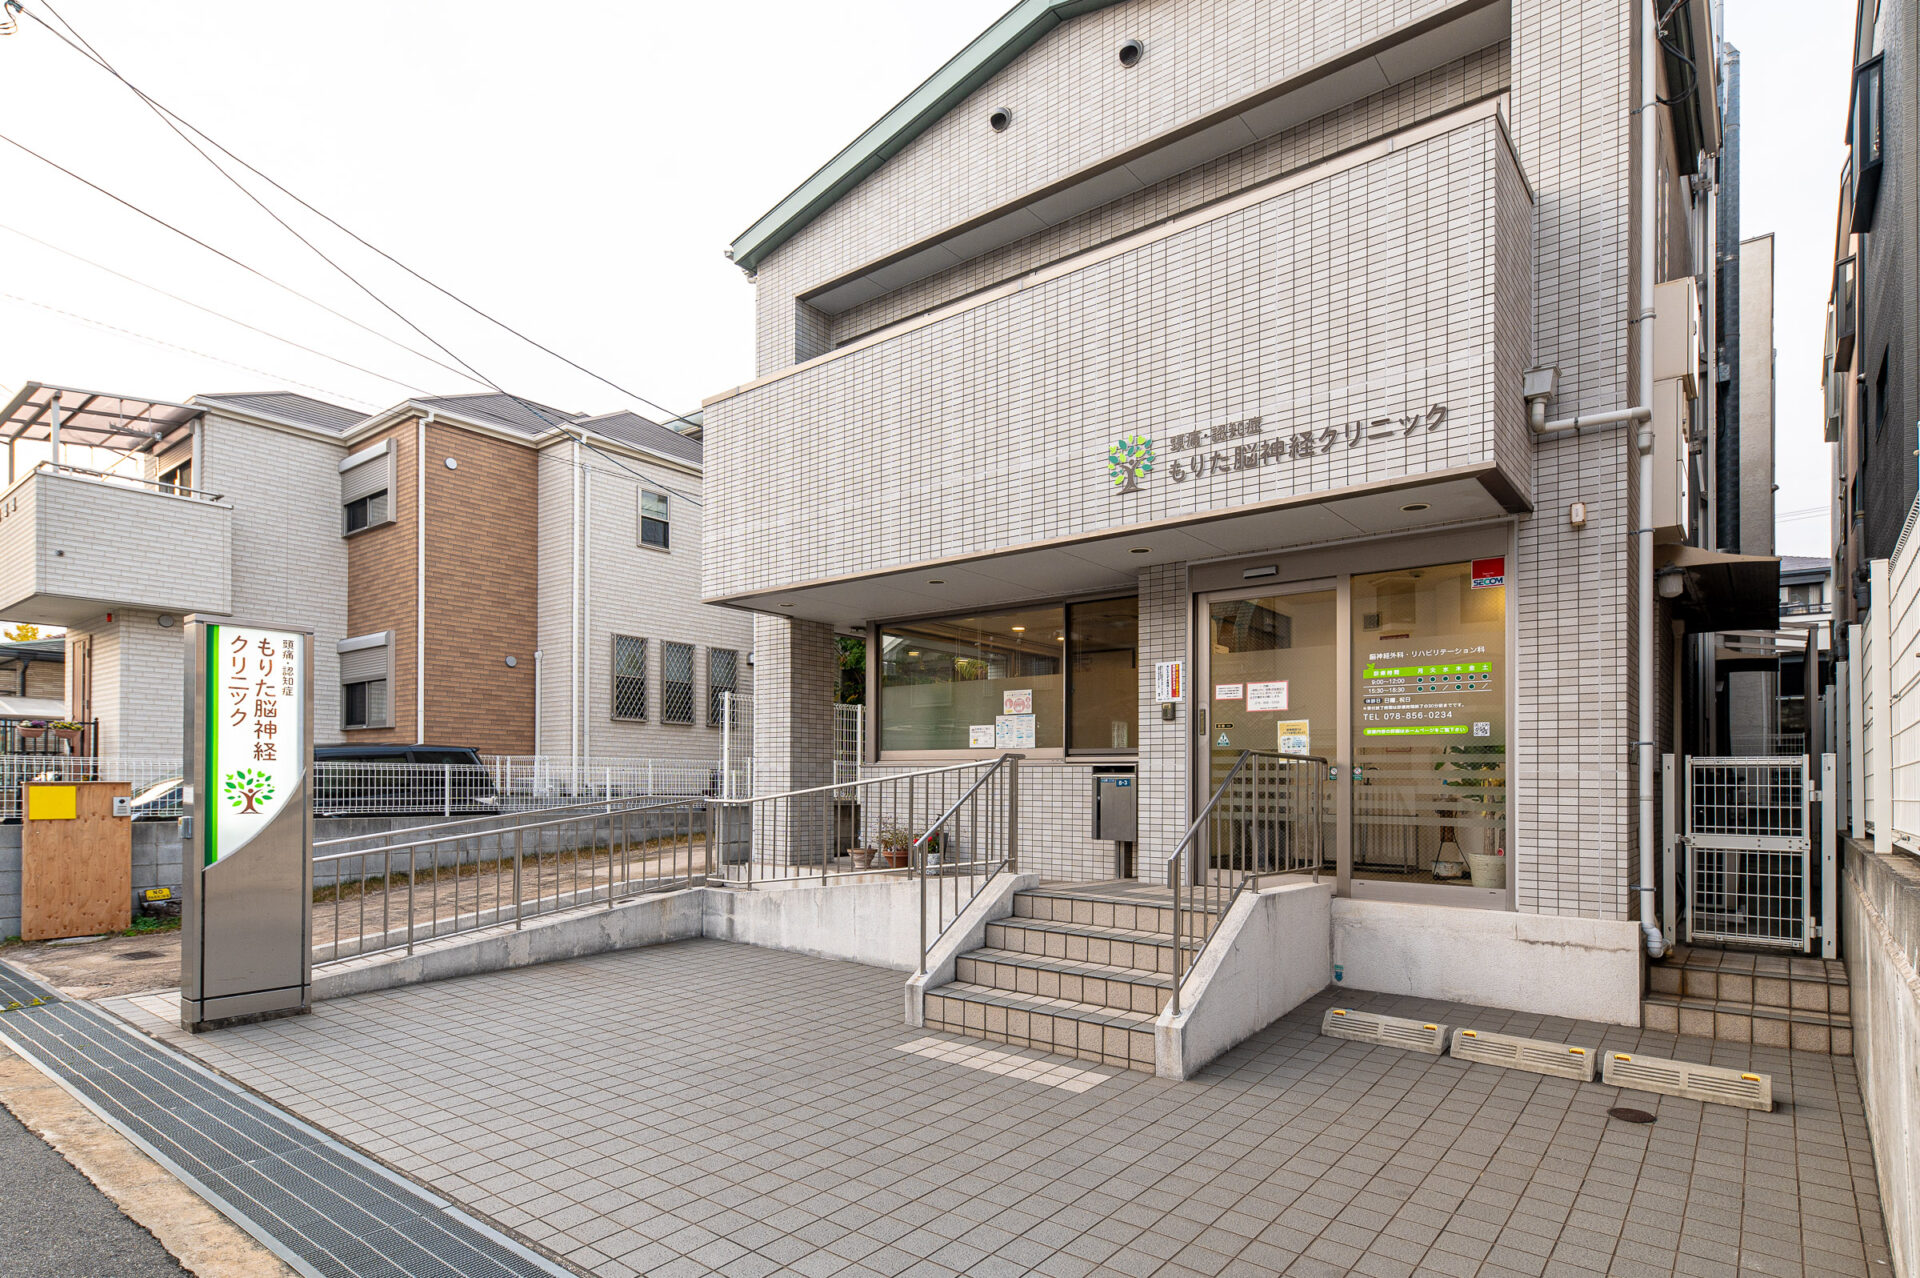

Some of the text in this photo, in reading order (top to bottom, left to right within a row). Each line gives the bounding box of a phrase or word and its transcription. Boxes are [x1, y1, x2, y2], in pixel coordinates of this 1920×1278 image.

[1168, 403, 1448, 483] もりた脳神経クリニック
[1170, 415, 1264, 452] 頭痛・認知症
[1473, 577, 1504, 587] SECOM
[228, 635, 250, 727] クリニック
[282, 639, 294, 697] 頭痛・認知症
[253, 637, 278, 761] もりた脳神経
[1363, 711, 1453, 721] TEL 078-856-0234
